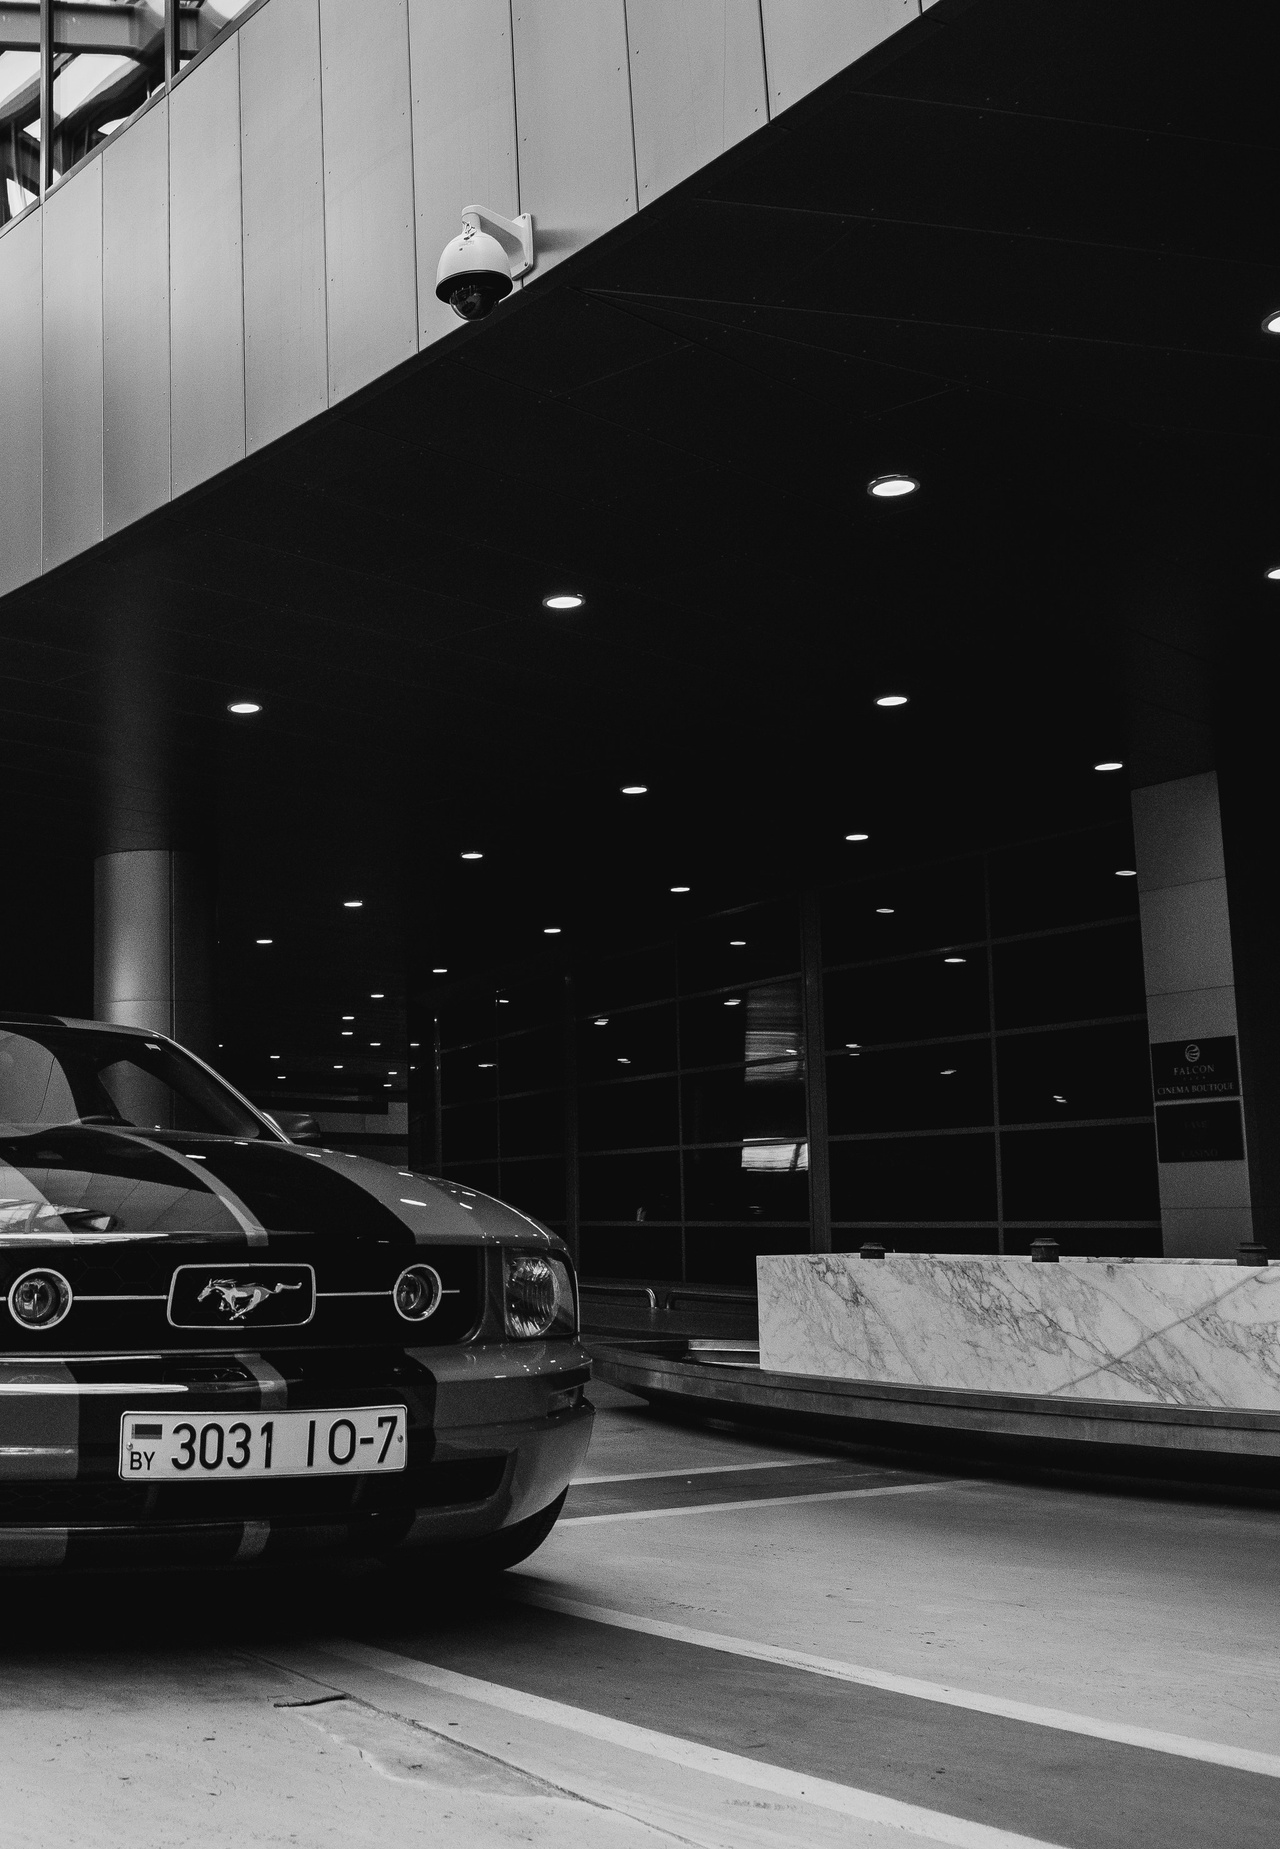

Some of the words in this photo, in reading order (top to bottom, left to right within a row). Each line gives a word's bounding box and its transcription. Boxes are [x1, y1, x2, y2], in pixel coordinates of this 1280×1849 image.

[1173, 1064, 1215, 1076] FALCON
[1157, 1086, 1190, 1095] CINEMA
[1191, 1082, 1233, 1092] BOUTIQUE
[129, 1451, 156, 1471] BY
[171, 1421, 273, 1470] 3031
